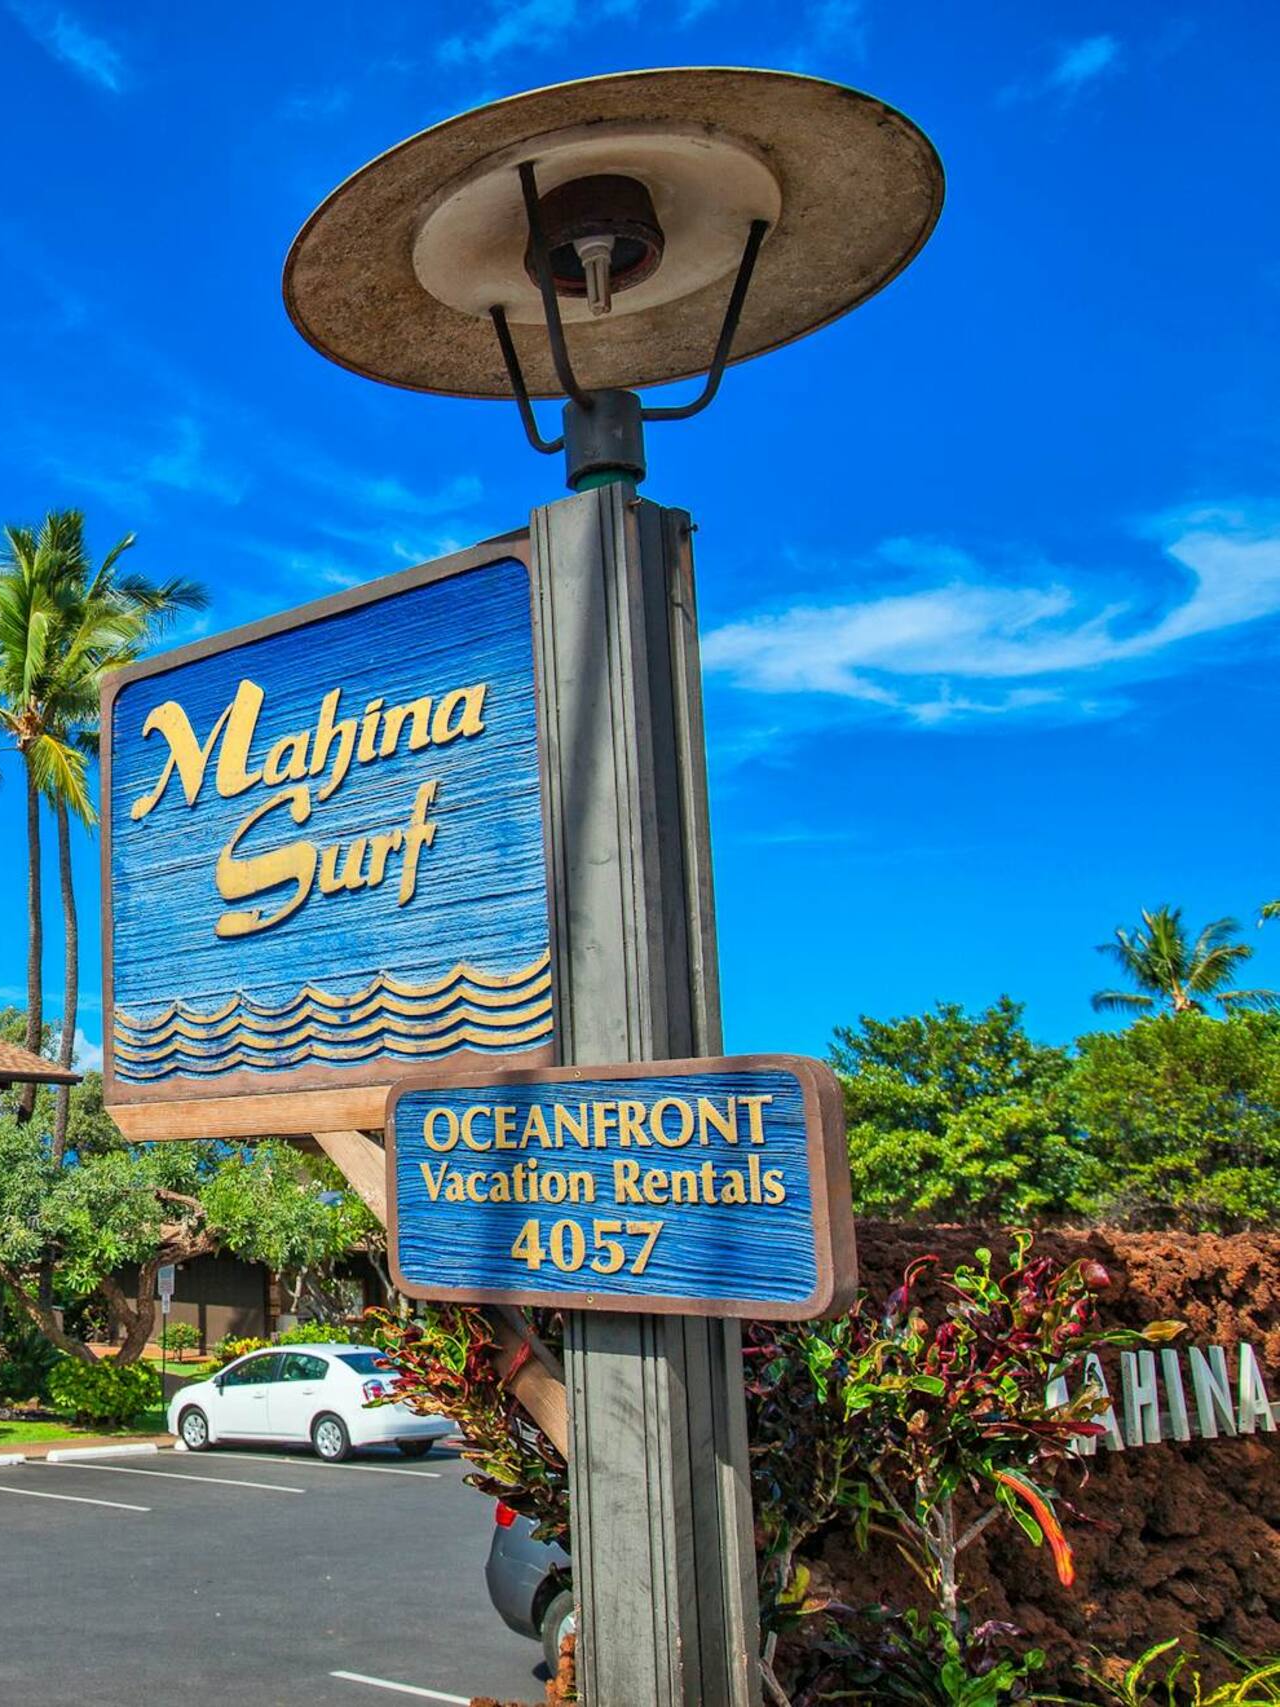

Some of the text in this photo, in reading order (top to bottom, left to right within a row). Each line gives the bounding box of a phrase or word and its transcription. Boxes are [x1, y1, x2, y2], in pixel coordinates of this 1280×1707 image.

[131, 679, 486, 821] Mahina
[214, 781, 439, 938] Surf
[422, 1095, 773, 1152] OCEANFRONT
[420, 1152, 787, 1205] Vacation Rentals
[510, 1219, 664, 1276] 4057
